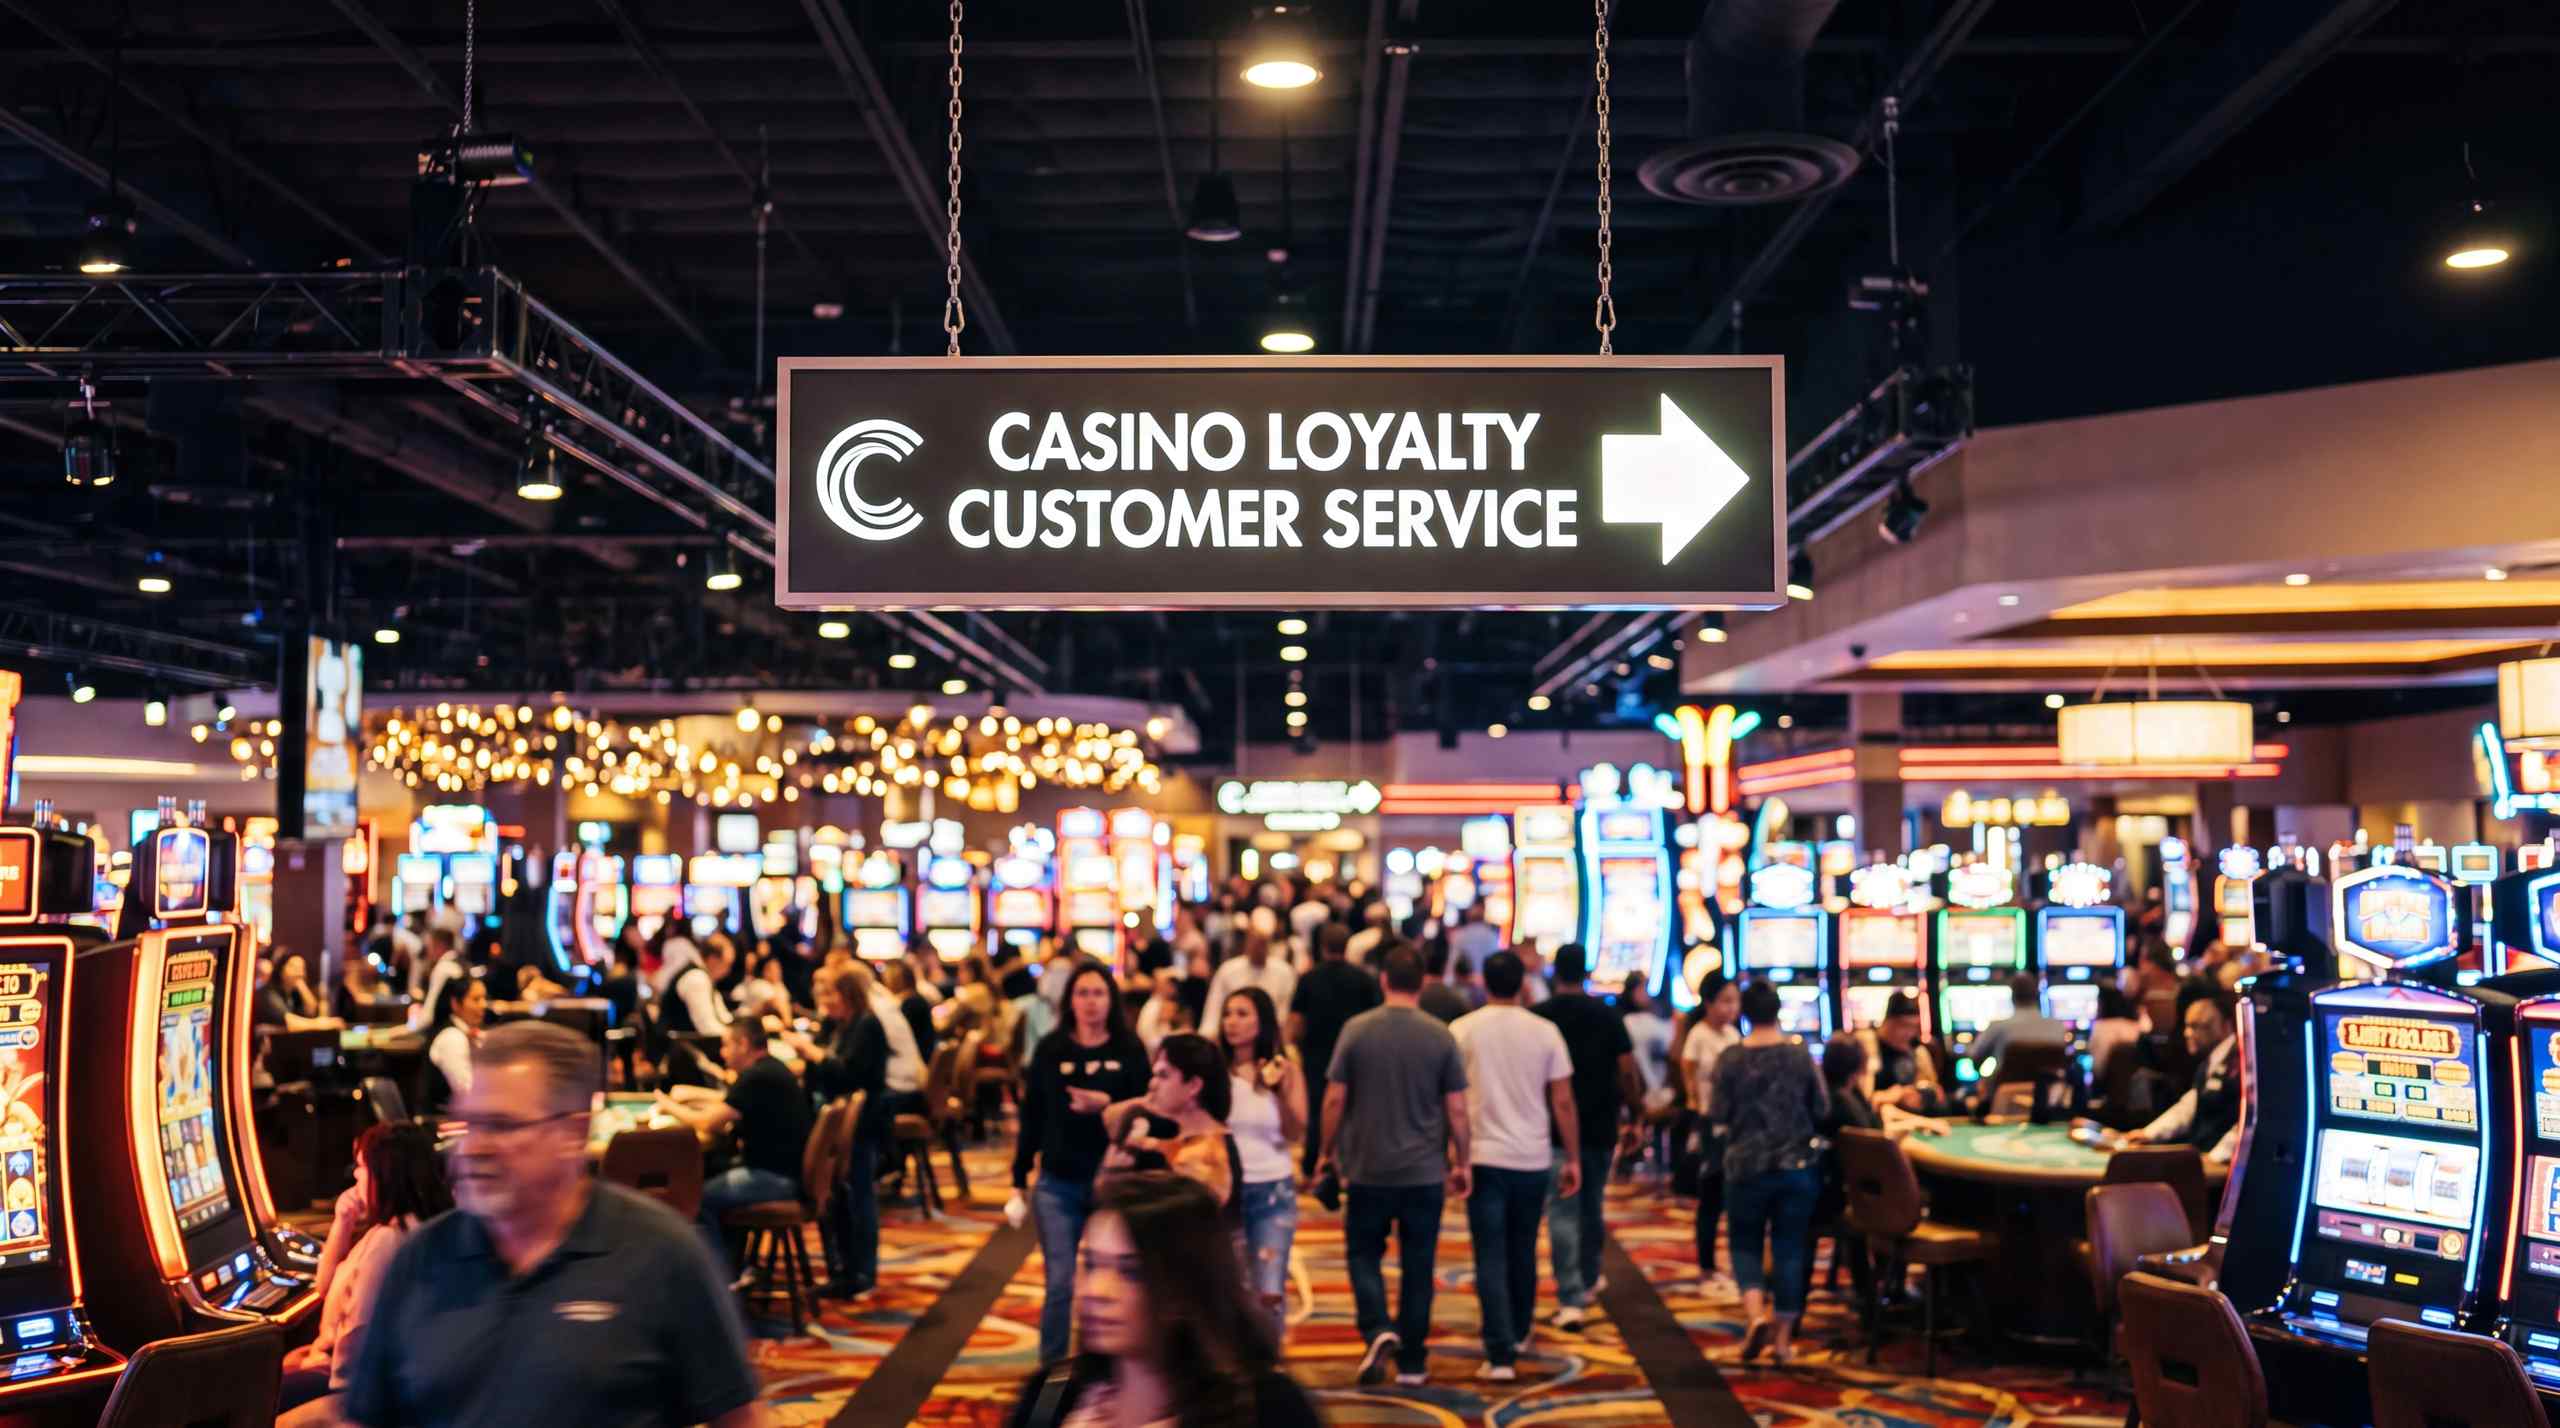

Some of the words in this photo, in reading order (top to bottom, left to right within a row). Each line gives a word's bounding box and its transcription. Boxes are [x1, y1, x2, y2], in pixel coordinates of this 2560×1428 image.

[988, 411, 1246, 472] CASINO
[1268, 411, 1541, 472] LOYALTY
[948, 488, 1303, 549] CUSTOMER
[1322, 488, 1578, 549] SERVICE
